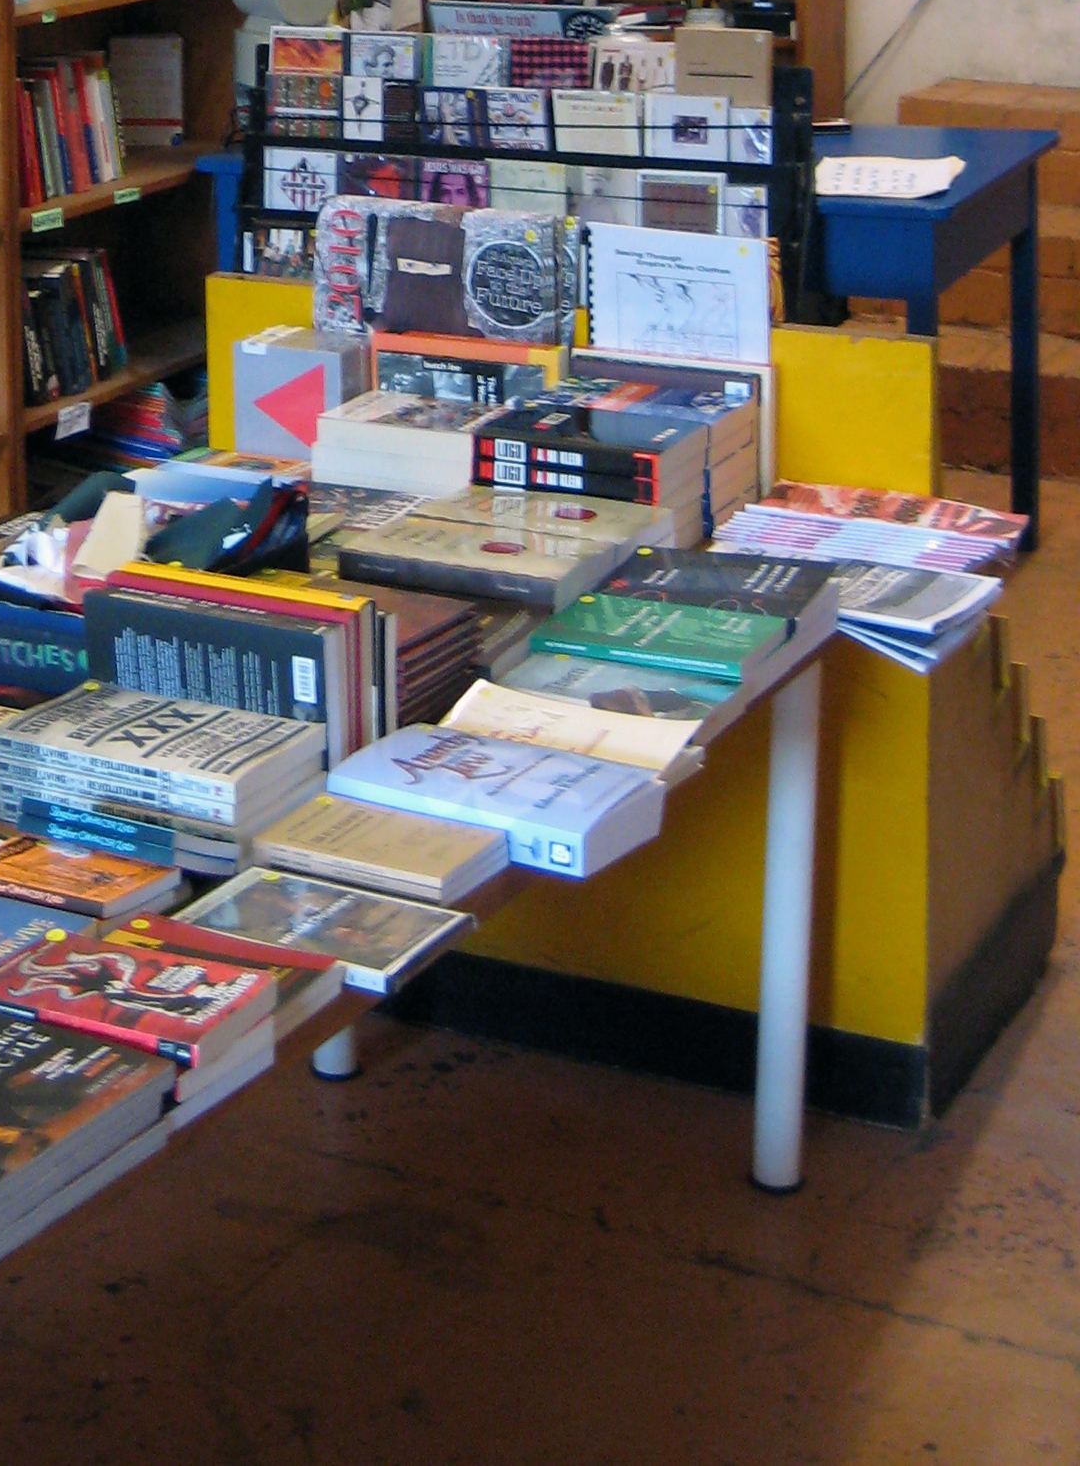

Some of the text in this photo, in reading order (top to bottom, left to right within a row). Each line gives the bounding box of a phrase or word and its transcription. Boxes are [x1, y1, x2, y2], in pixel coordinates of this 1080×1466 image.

[466, 12, 488, 26] that
[488, 14, 505, 26] the
[645, 251, 682, 263] Through
[476, 259, 542, 290] Face Up
[475, 286, 544, 316] Future
[66, 696, 160, 742] REVOLUTION
